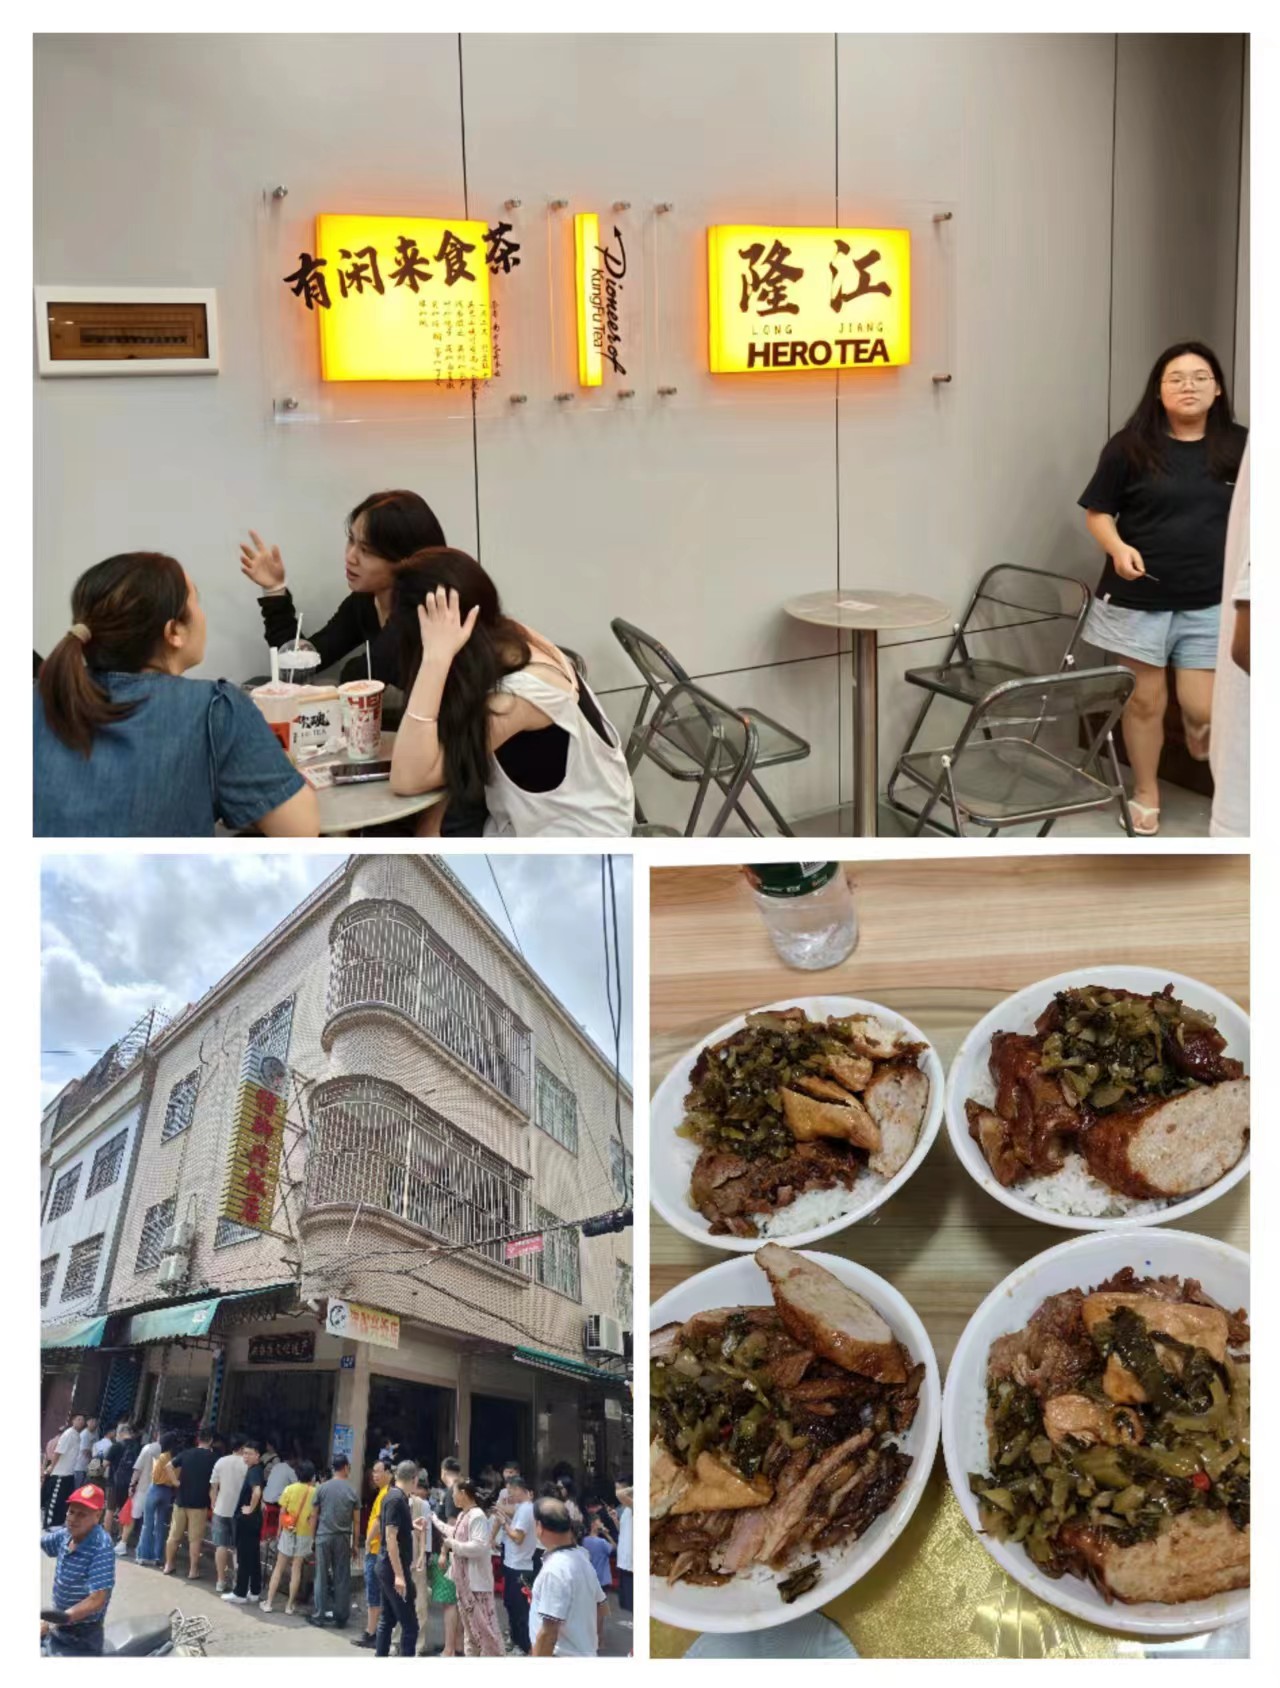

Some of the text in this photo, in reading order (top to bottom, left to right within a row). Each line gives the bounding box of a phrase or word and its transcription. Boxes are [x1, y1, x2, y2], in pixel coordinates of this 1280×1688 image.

[283, 221, 521, 310] 有闲来食茶
[738, 239, 892, 317] 隆江
[747, 338, 890, 368] HERO TEA
[751, 321, 884, 336] LONG JIANG
